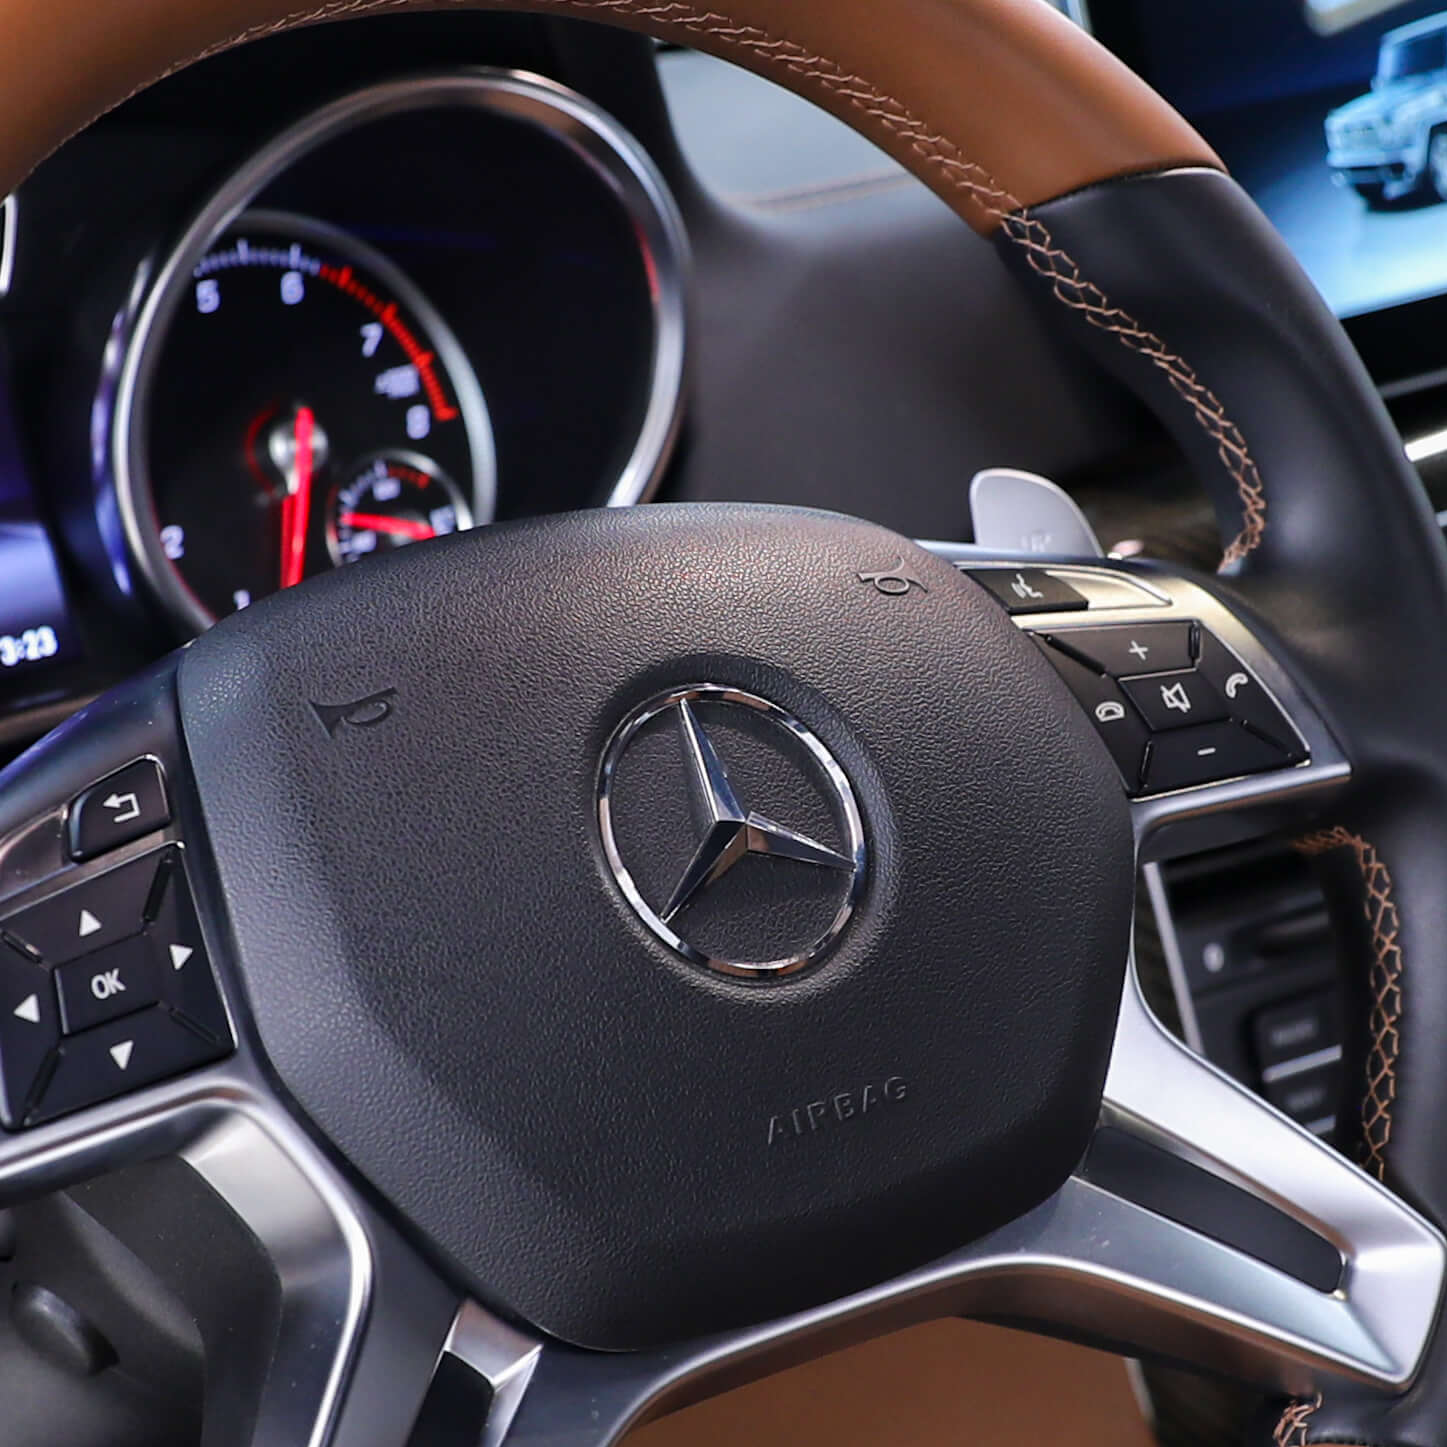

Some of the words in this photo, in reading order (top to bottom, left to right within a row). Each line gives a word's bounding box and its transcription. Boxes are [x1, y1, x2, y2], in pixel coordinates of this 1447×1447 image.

[196, 278, 221, 315] 5
[360, 322, 383, 358] 7
[160, 524, 185, 560] 2
[90, 967, 127, 1000] OK
[766, 1074, 908, 1146] AIRBAG
